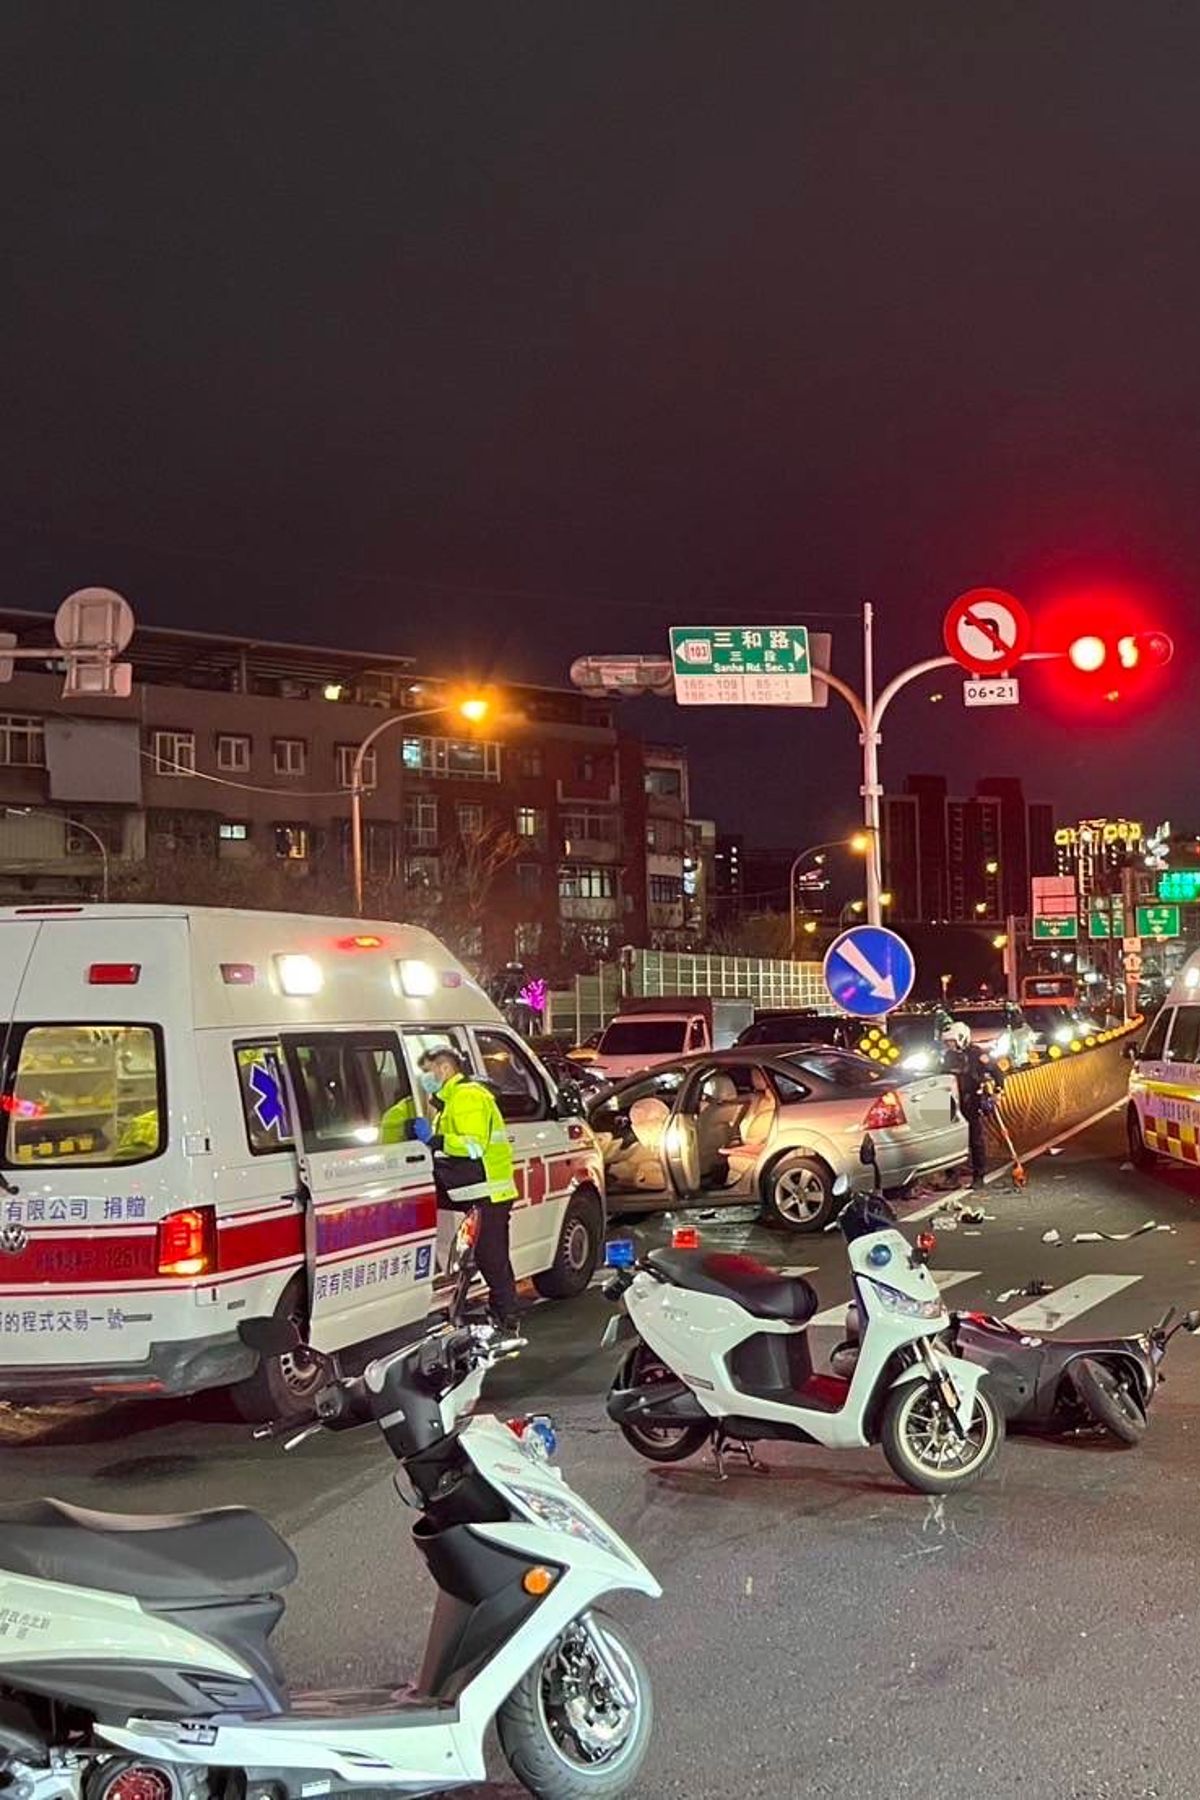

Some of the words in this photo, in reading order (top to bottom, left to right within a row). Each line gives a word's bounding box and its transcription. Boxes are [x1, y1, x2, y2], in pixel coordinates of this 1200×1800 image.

[713, 631, 790, 649] 三和路
[6, 1198, 89, 1221] 有限公司
[104, 1195, 146, 1219] 捐贈
